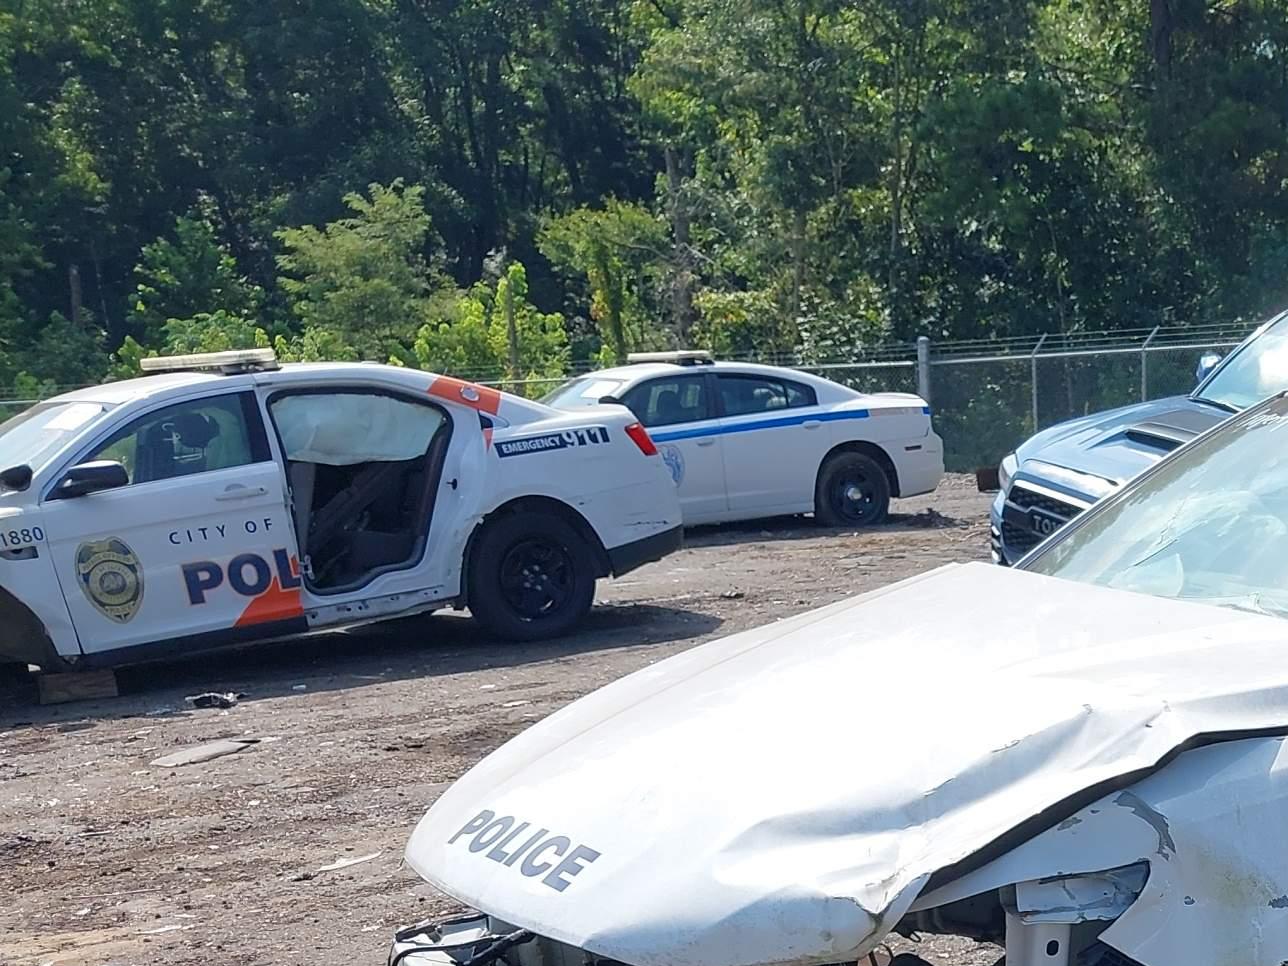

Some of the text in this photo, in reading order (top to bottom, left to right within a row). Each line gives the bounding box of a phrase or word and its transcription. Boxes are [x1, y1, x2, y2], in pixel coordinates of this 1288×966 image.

[501, 426, 610, 454] EMERGENCY 911
[0, 526, 44, 547] 1880
[169, 518, 273, 545] CITY OF
[181, 547, 302, 606] POL
[447, 809, 602, 893] POLICE
